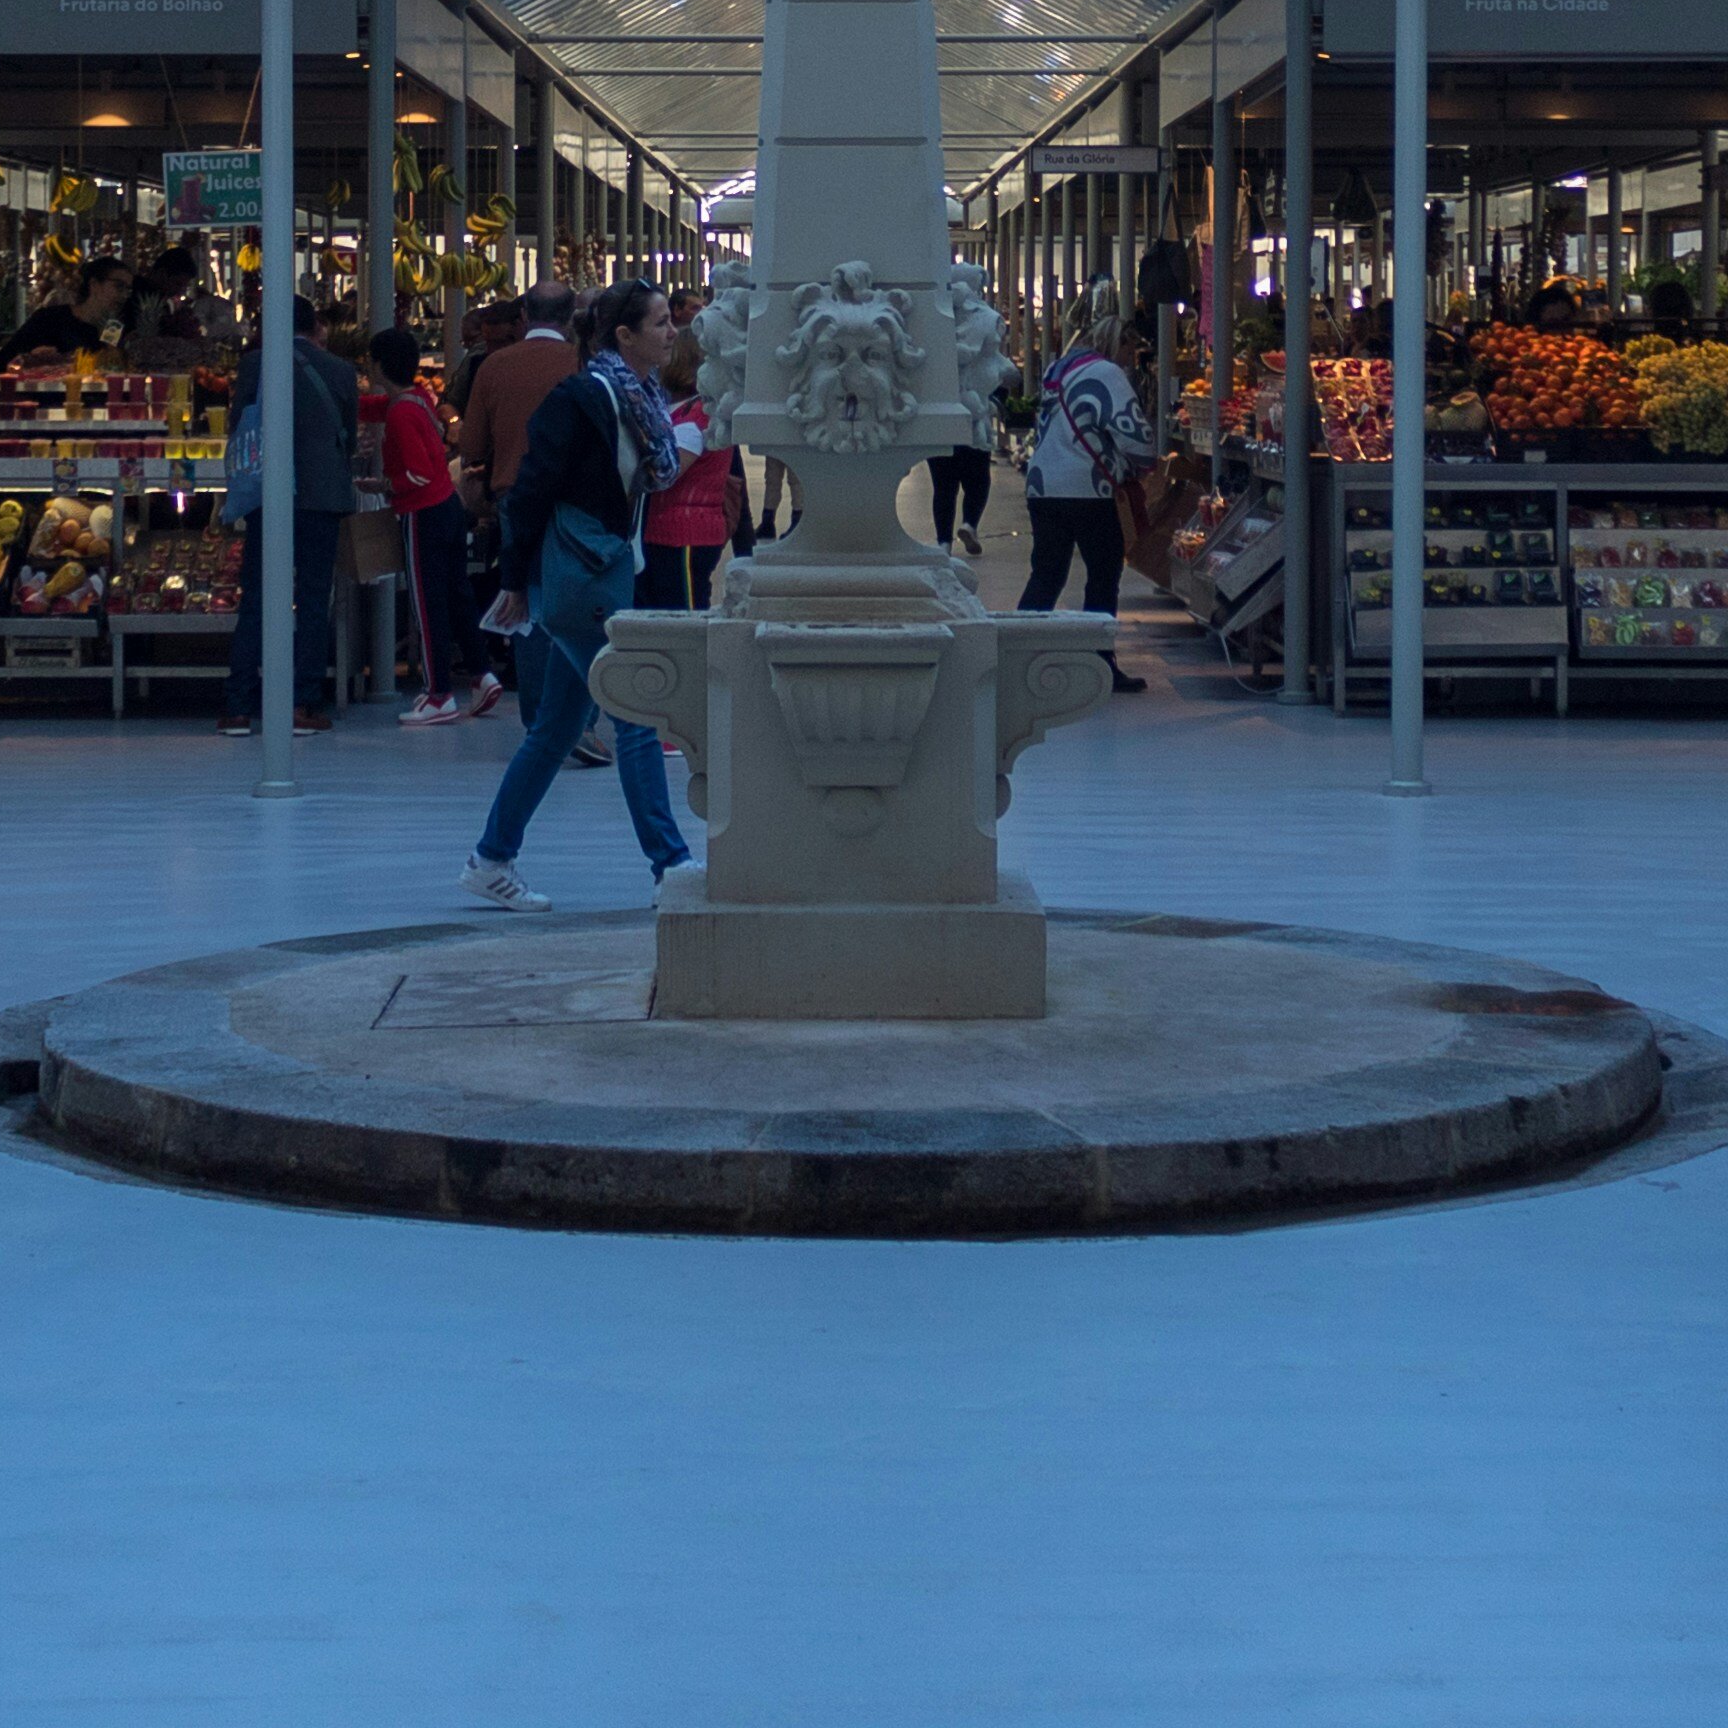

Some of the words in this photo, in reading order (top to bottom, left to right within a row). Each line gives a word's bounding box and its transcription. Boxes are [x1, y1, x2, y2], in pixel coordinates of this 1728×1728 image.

[1516, 0, 1539, 12] na
[169, 154, 251, 173] Natural
[1043, 153, 1065, 164] Rua
[1067, 153, 1080, 164] da
[1082, 152, 1116, 164] Glória
[207, 173, 262, 193] Juices
[218, 201, 263, 219] 2.00
